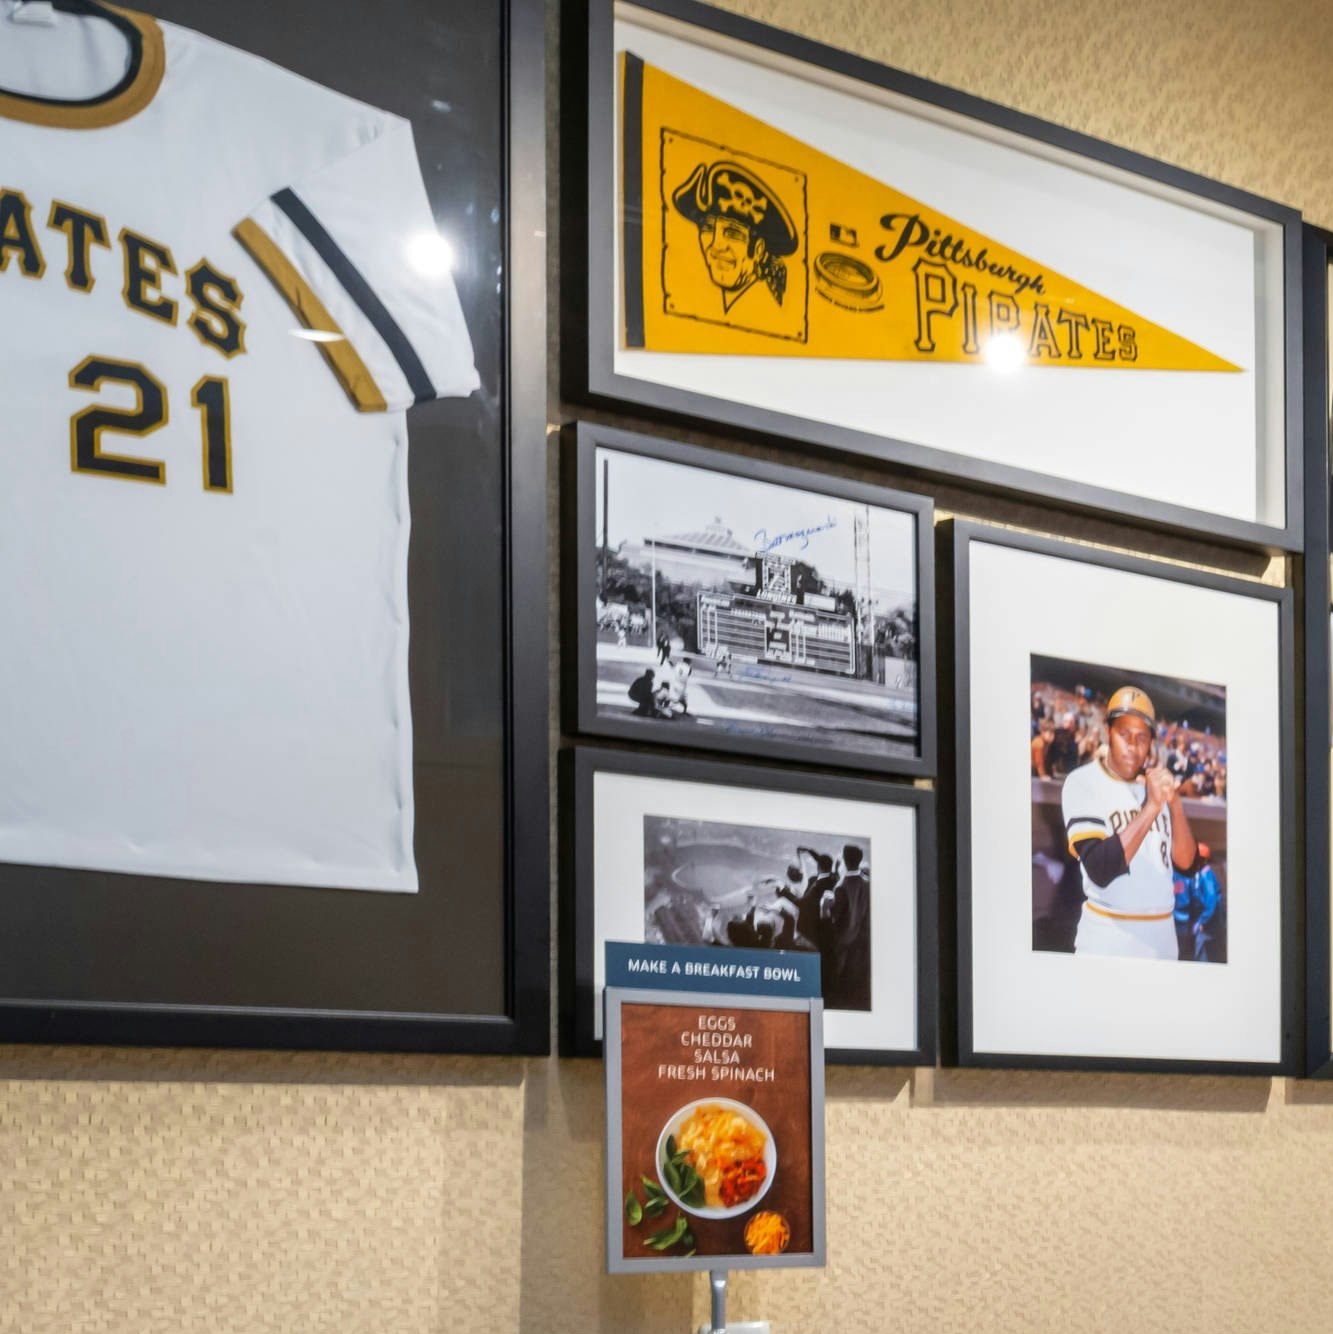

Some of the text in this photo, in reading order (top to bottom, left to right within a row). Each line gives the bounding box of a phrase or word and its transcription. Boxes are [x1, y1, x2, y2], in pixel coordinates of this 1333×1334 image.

[875, 211, 1046, 295] Pittsburgh
[911, 259, 1138, 364] PIRATES
[67, 354, 235, 495] 21
[628, 958, 801, 982] MAKE A BREAKFAST BOWL
[697, 1014, 737, 1030] EGGS
[680, 1031, 753, 1048] CHEDDAR
[693, 1049, 741, 1064] SALSA
[657, 1064, 775, 1082] FRESH SPINACH
